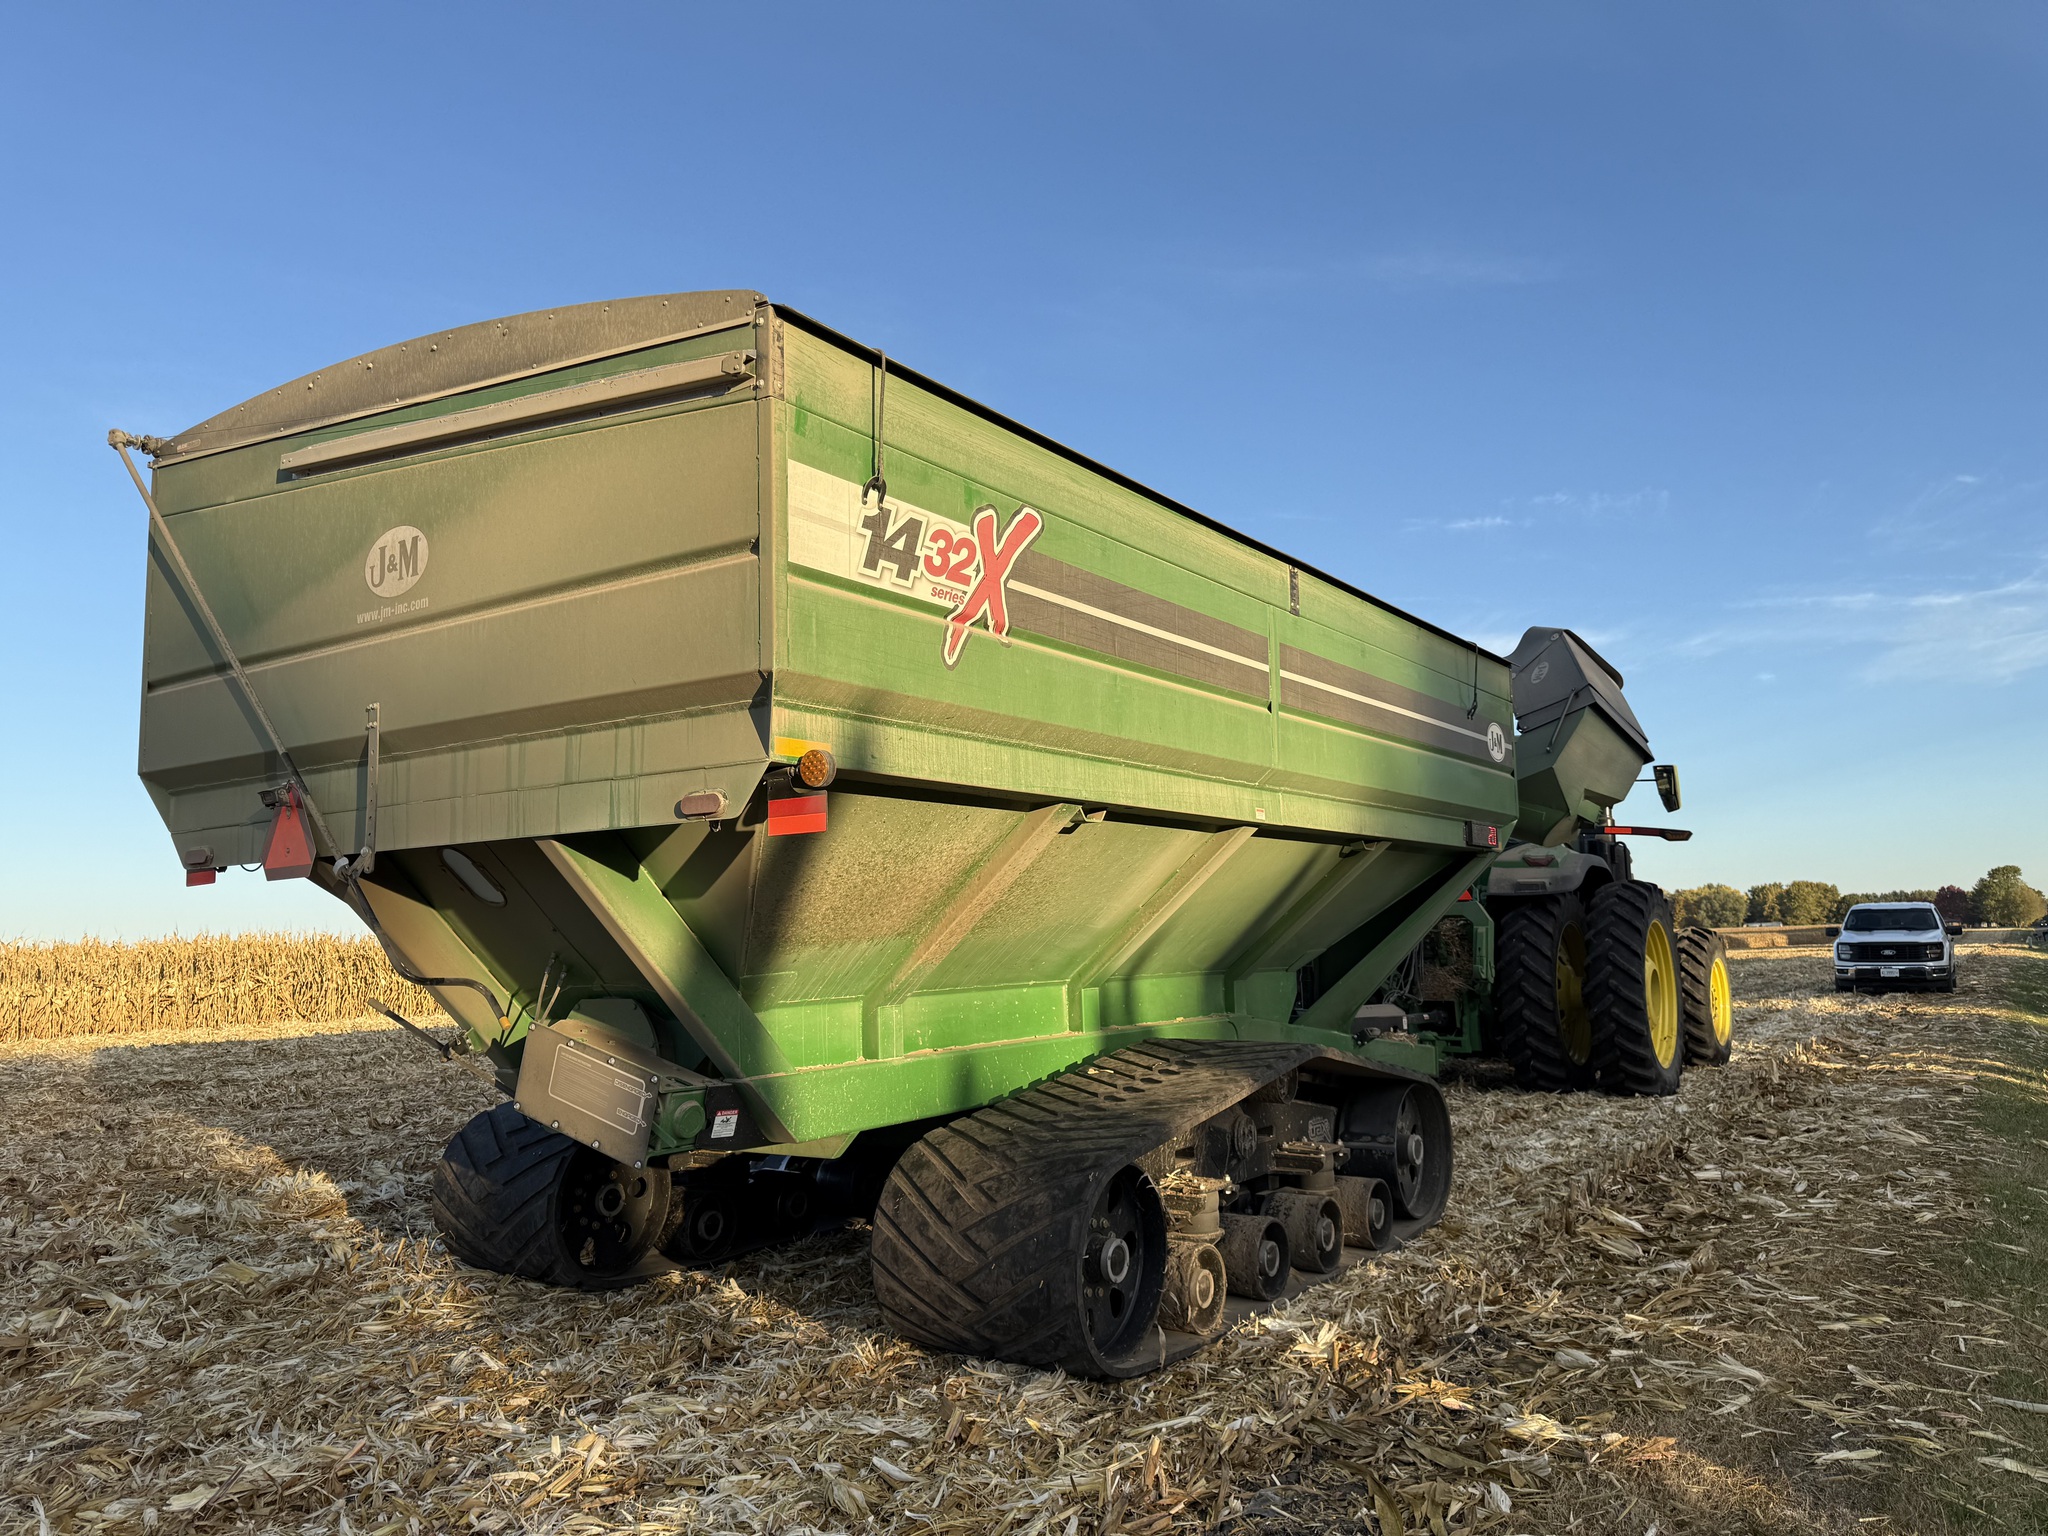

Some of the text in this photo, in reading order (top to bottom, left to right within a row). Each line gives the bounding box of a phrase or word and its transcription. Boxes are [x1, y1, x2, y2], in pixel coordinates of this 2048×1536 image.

[369, 535, 420, 589] J&M
[930, 586, 966, 606] series
[356, 597, 429, 624] www.jm-inc.com
[1489, 731, 1503, 755] J&M
